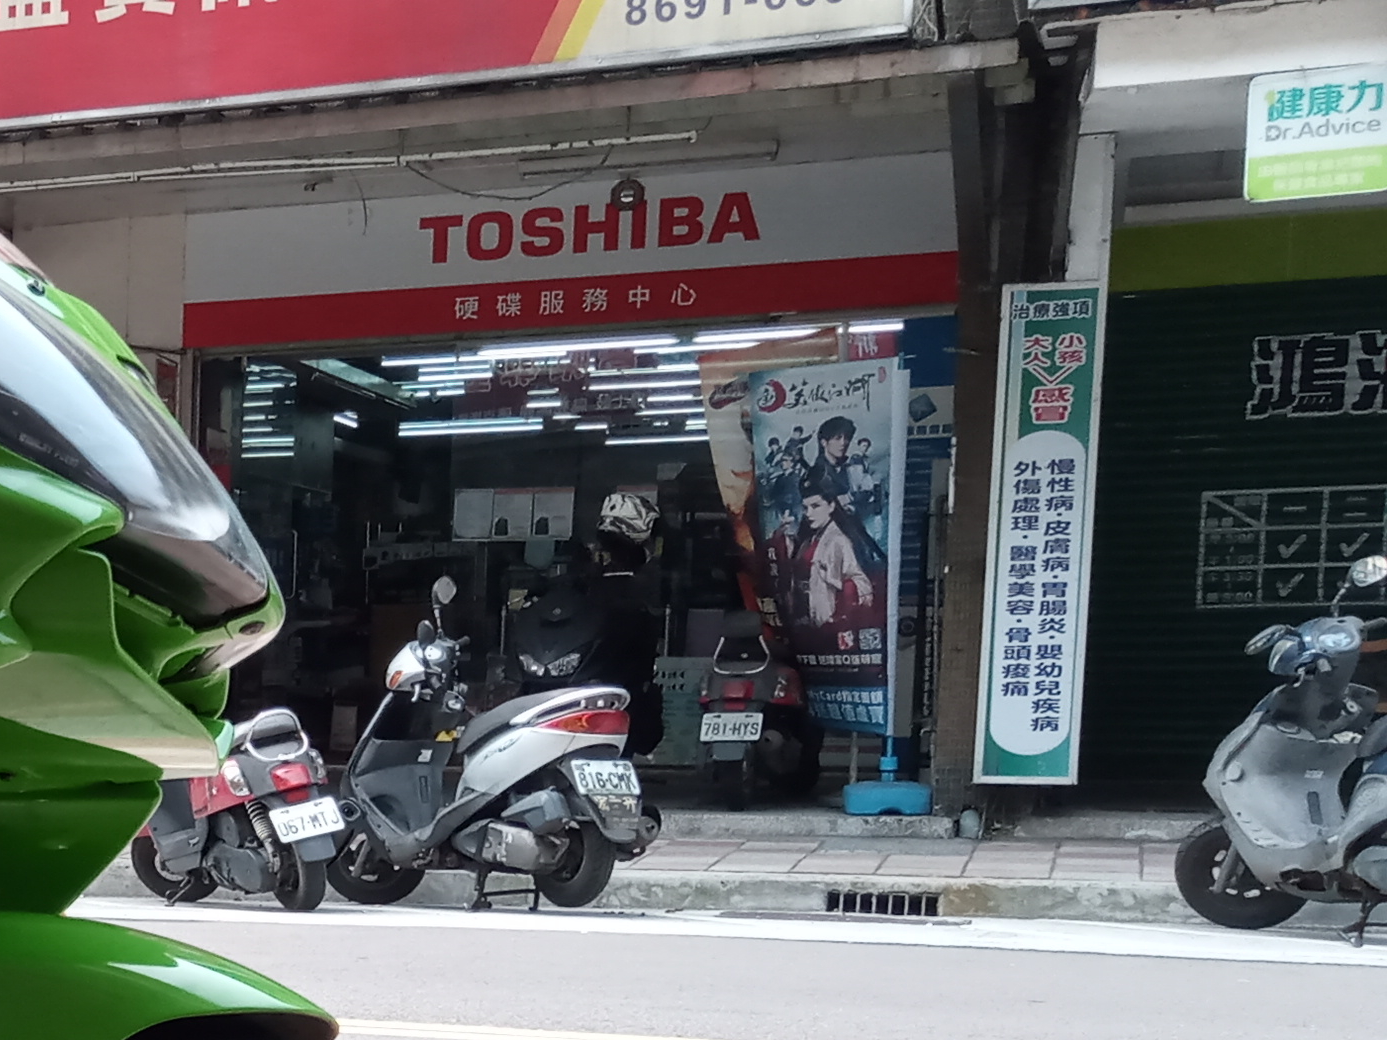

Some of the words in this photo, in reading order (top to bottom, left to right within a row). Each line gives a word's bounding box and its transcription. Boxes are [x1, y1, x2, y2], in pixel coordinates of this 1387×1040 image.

[1266, 79, 1385, 122] 健康力
[1264, 118, 1382, 143] Dr.Advice
[419, 191, 761, 264] TOSHIBA
[453, 282, 698, 320] 硬碟服務中心
[1012, 299, 1091, 321] 治療強項
[1023, 335, 1051, 366] 大人
[1056, 334, 1085, 365] 小孩
[1031, 386, 1074, 422] 感冒
[703, 722, 759, 737] 781-HYS
